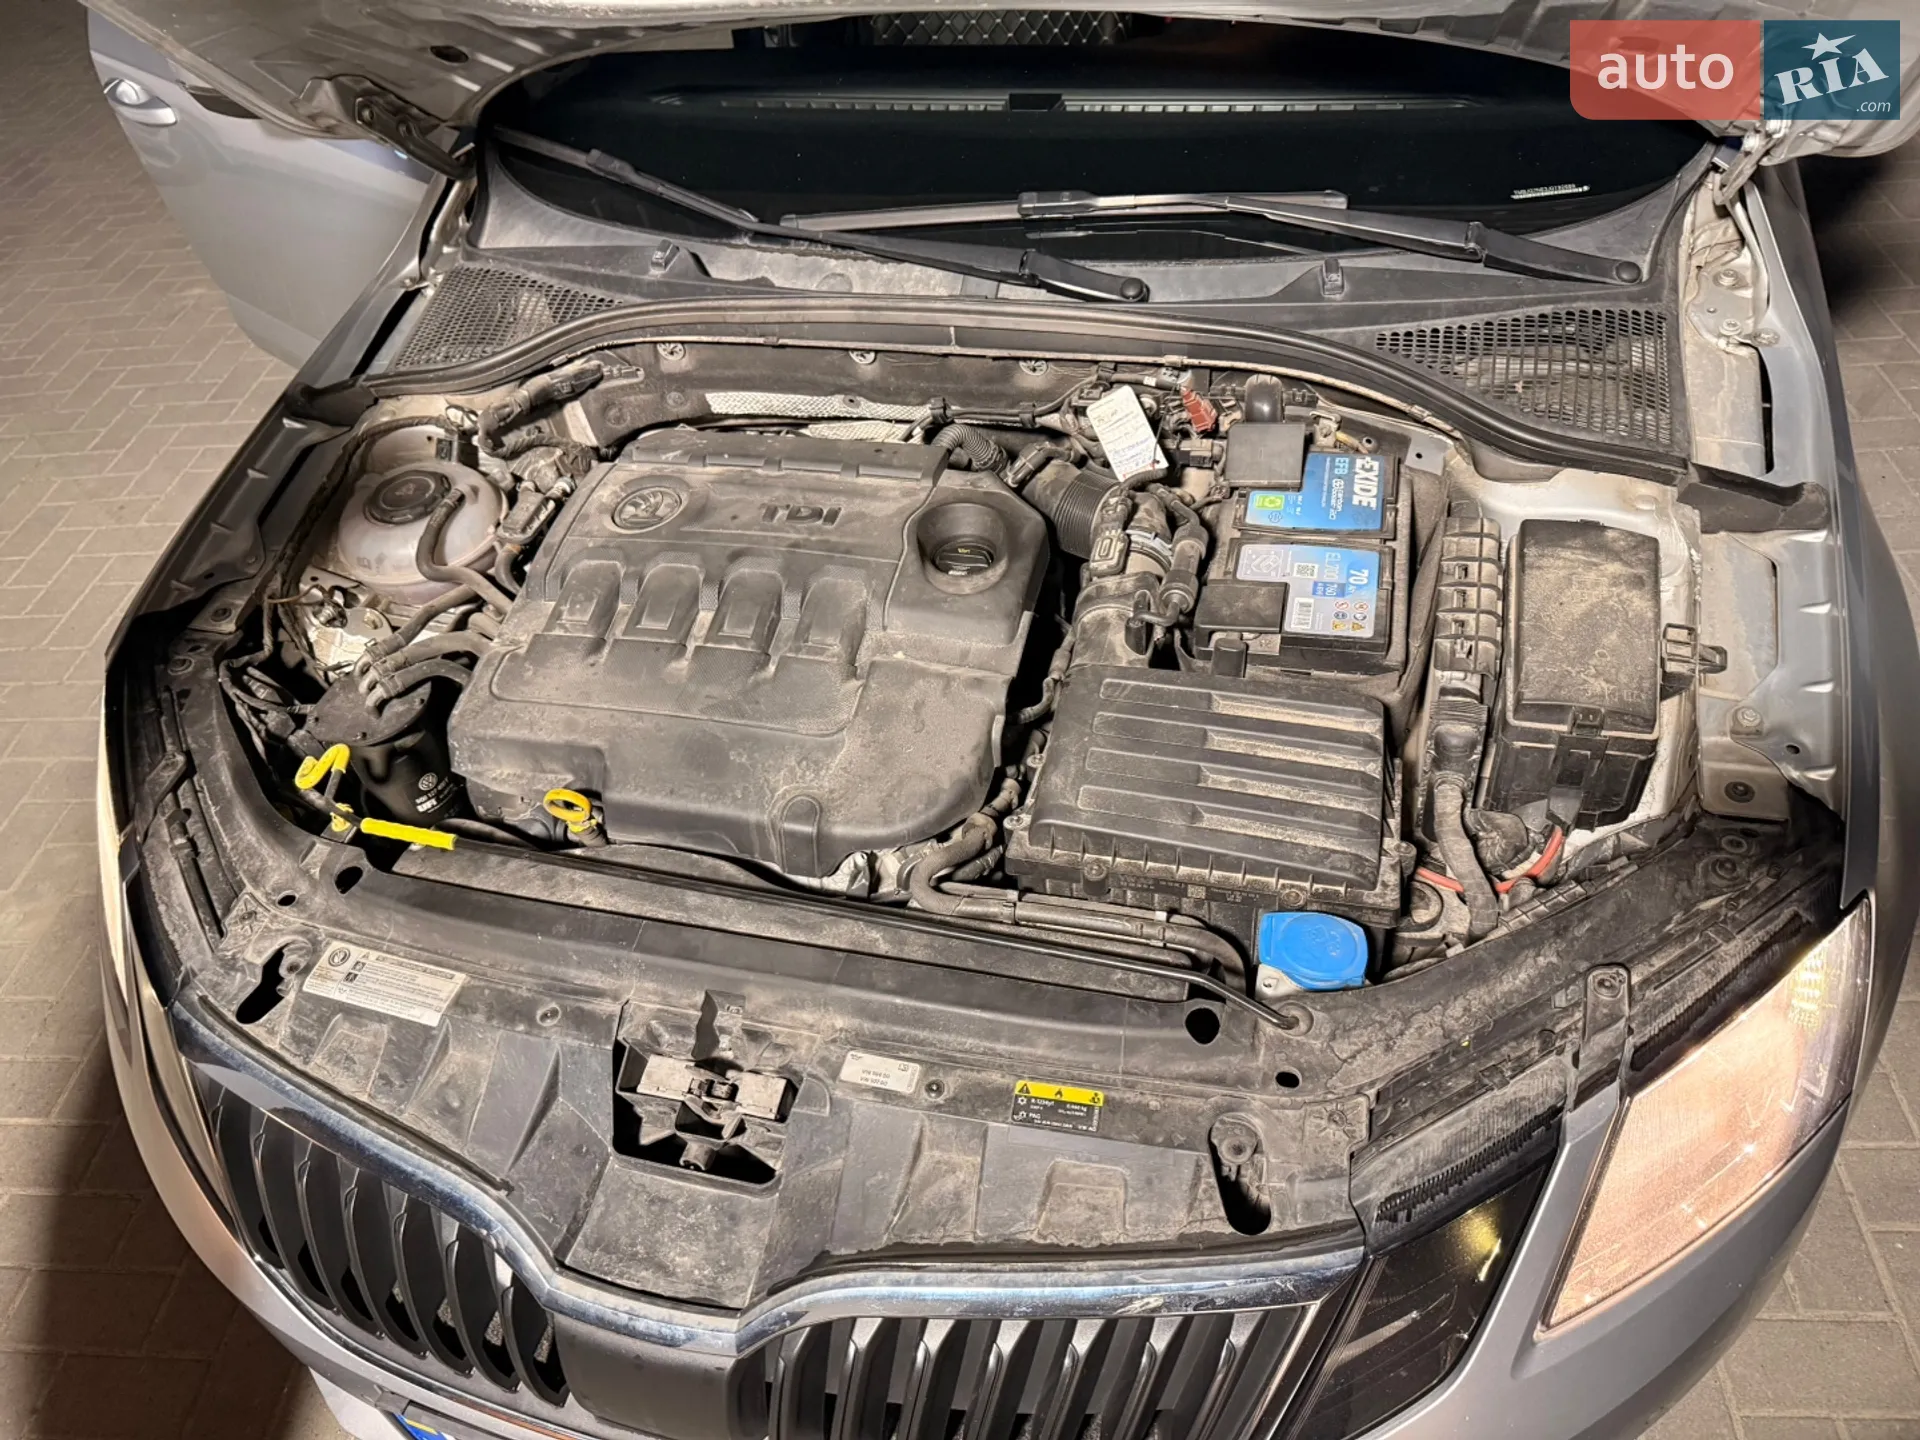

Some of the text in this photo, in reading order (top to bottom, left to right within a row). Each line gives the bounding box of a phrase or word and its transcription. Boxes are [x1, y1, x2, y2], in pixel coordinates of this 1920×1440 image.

[1334, 457, 1349, 475] EFB
[1351, 456, 1380, 508] EXIDE
[757, 503, 843, 527] TDI
[1348, 568, 1369, 585] 70
[1325, 583, 1338, 596] 760
